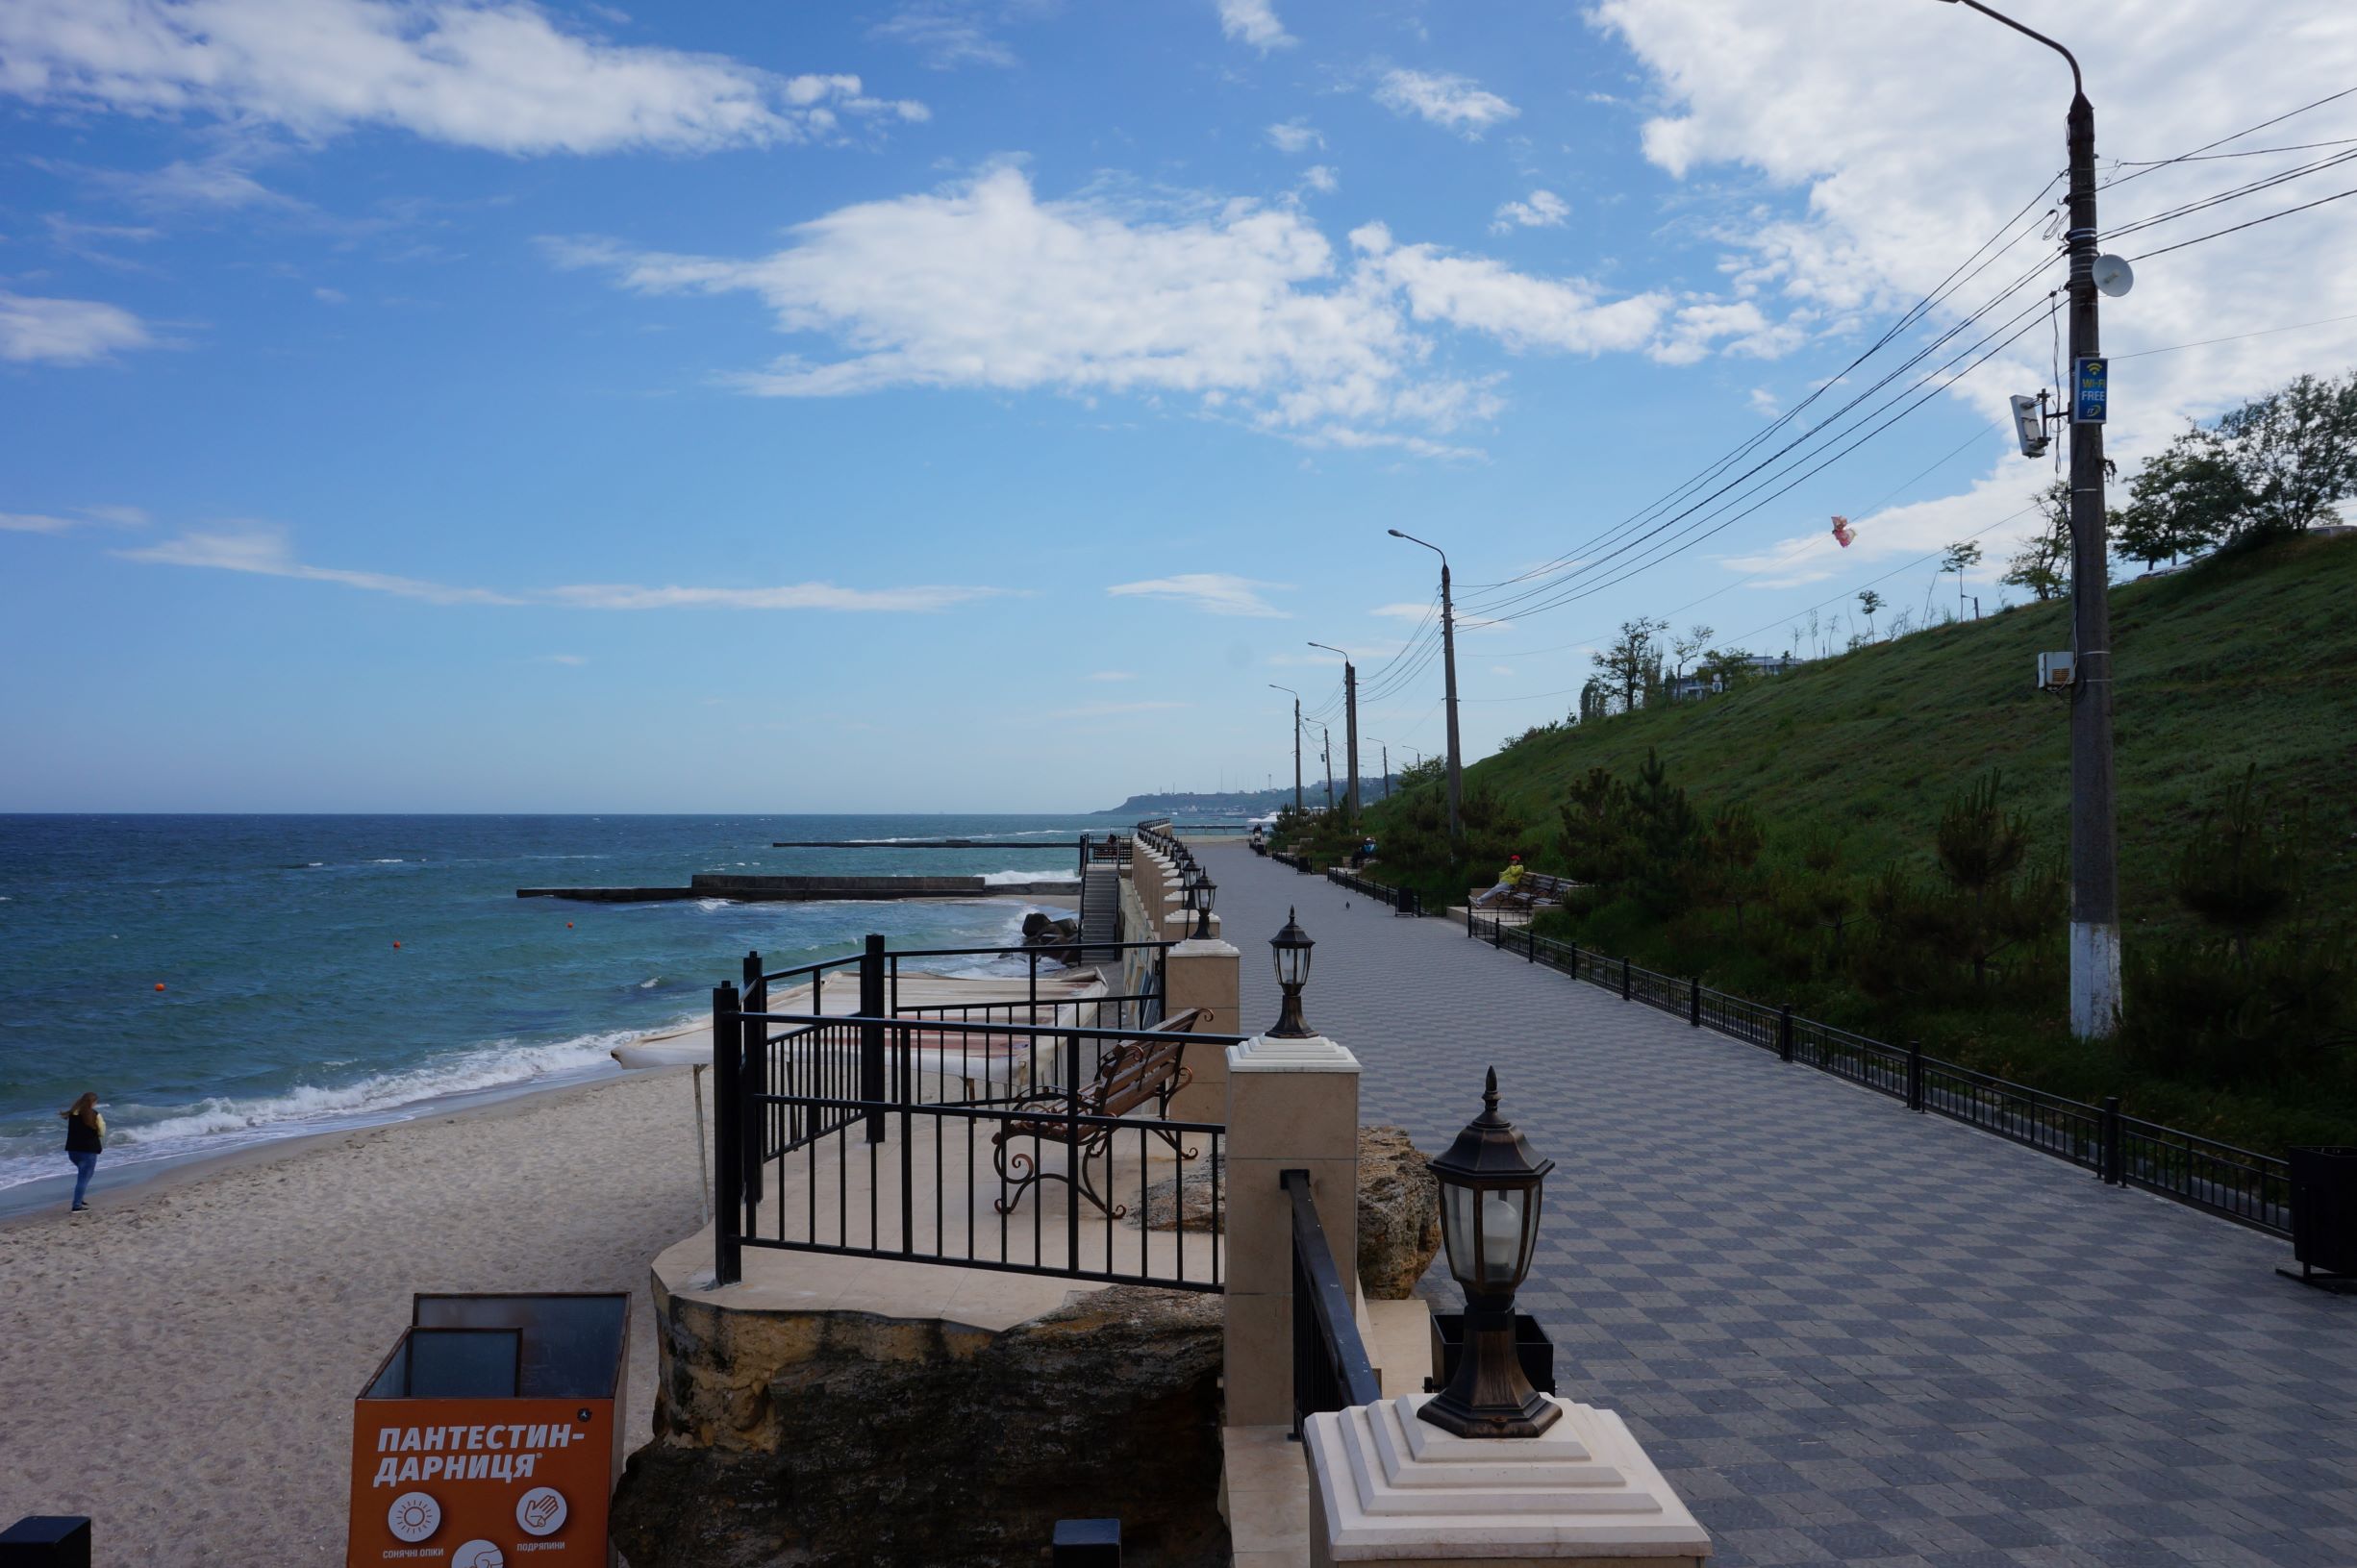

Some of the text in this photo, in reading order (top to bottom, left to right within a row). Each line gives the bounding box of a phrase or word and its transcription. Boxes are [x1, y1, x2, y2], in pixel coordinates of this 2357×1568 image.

[2081, 391, 2105, 401] FREE
[377, 1424, 585, 1452] ПАНТЕСТИН-
[516, 1541, 565, 1553] ПОДРЯПИНИ
[383, 1548, 443, 1559] СОНЯЧНІ ОПІКИ
